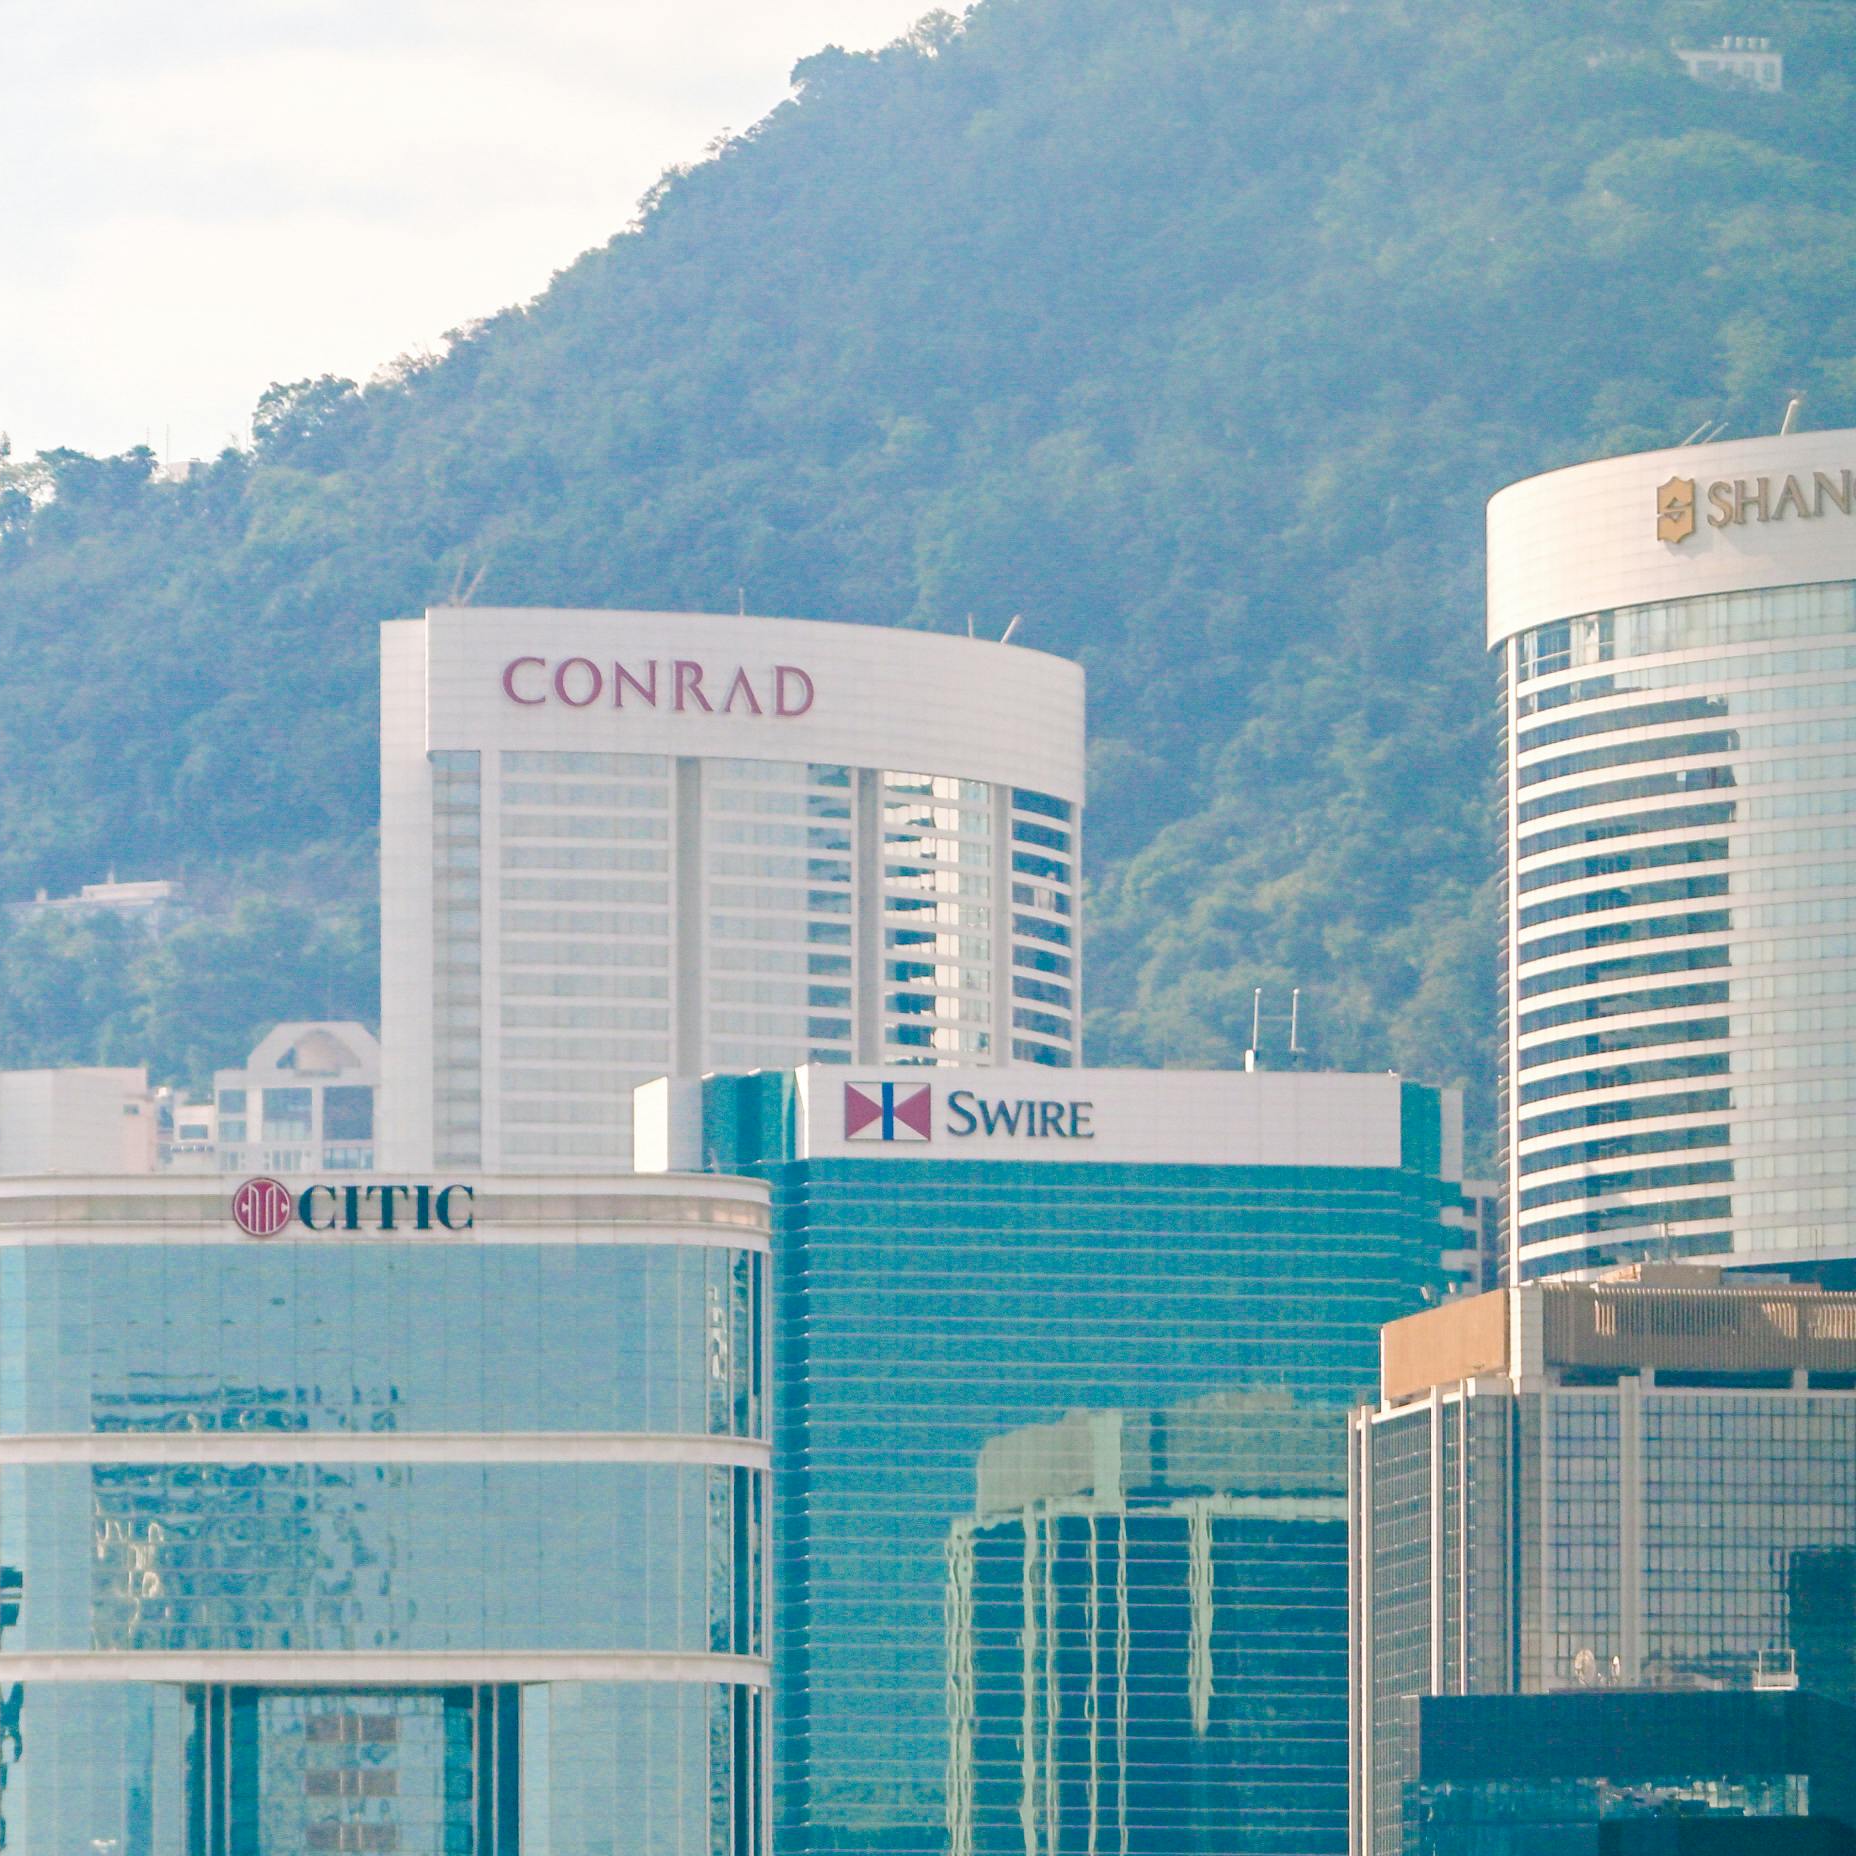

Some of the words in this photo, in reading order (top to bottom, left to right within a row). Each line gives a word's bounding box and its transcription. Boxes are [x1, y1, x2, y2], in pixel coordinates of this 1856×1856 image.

[1706, 468, 1856, 528] SHAN
[501, 655, 815, 717] CONRAD
[298, 1184, 475, 1231] CITIC
